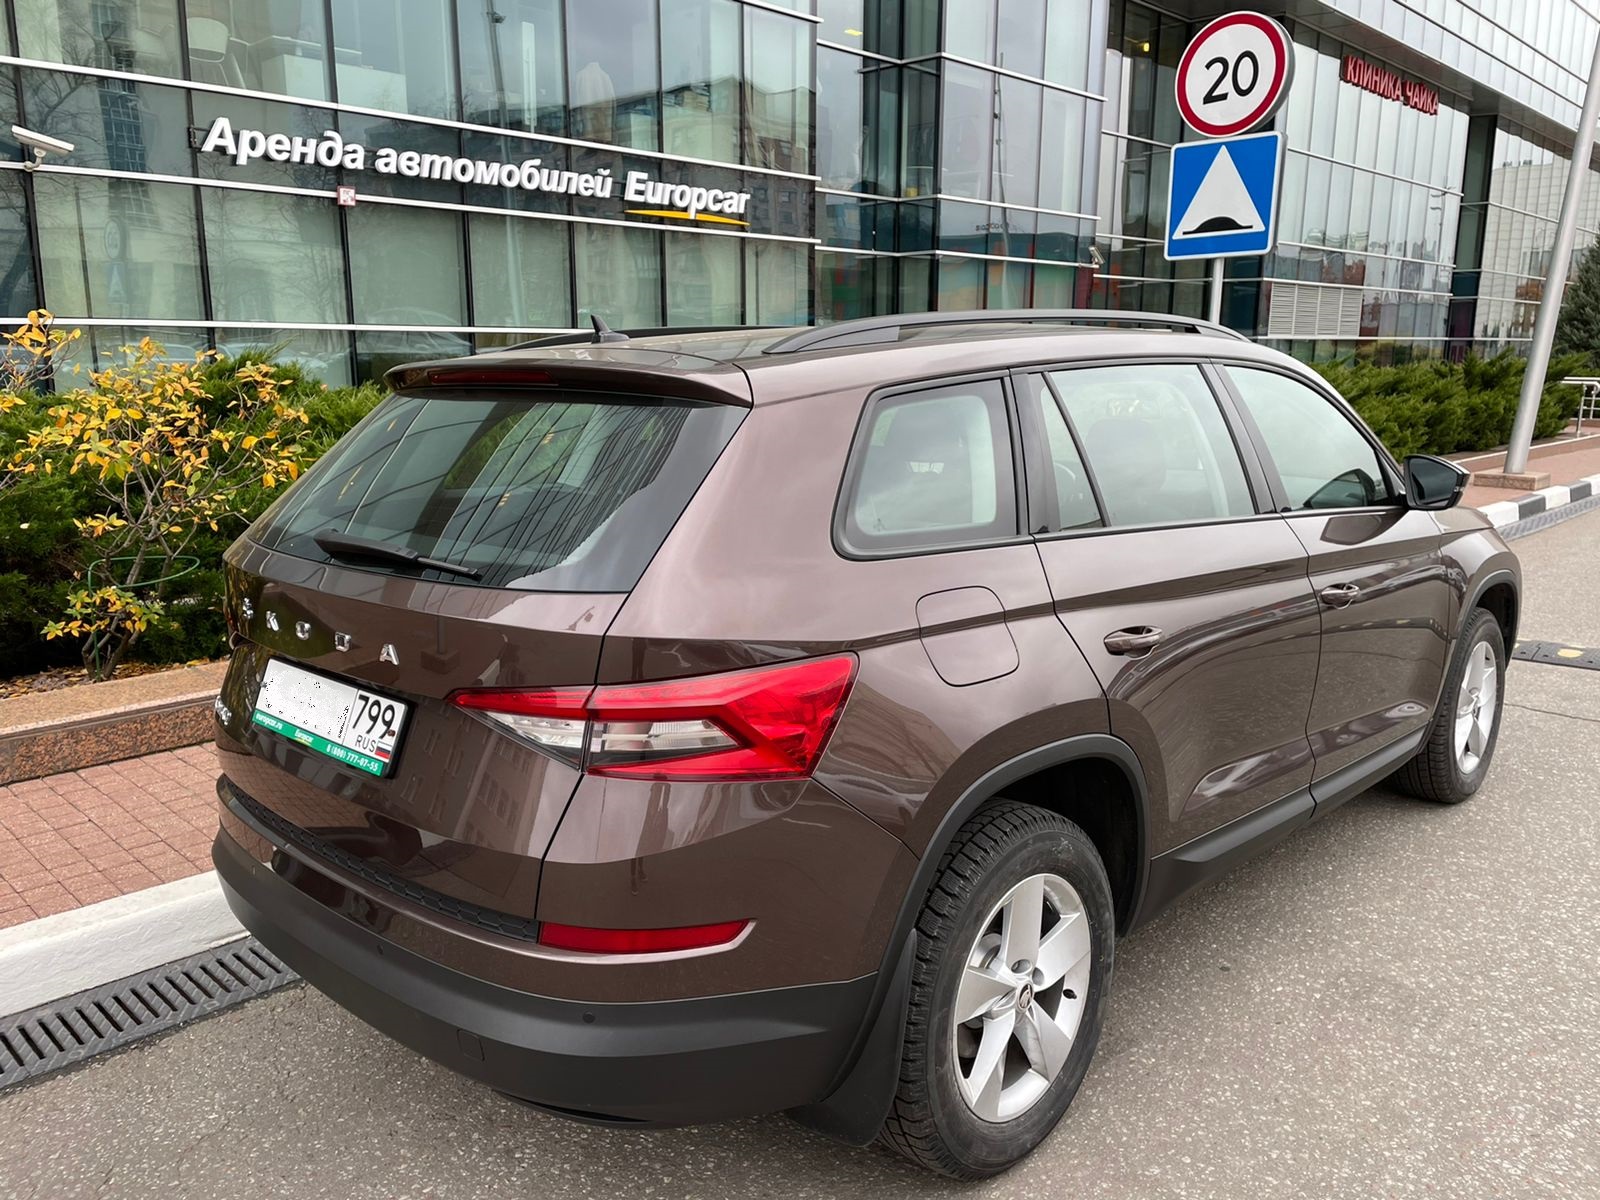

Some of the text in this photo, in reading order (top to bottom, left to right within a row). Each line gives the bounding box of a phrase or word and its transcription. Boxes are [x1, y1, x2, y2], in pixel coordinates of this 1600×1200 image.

[1203, 50, 1259, 105] 20
[1345, 55, 1439, 115] КЛИНИКА ЧАЙКА
[201, 116, 750, 219] Аренда автомобилей Europcar
[353, 694, 395, 739] 799
[354, 735, 376, 752] RUS
